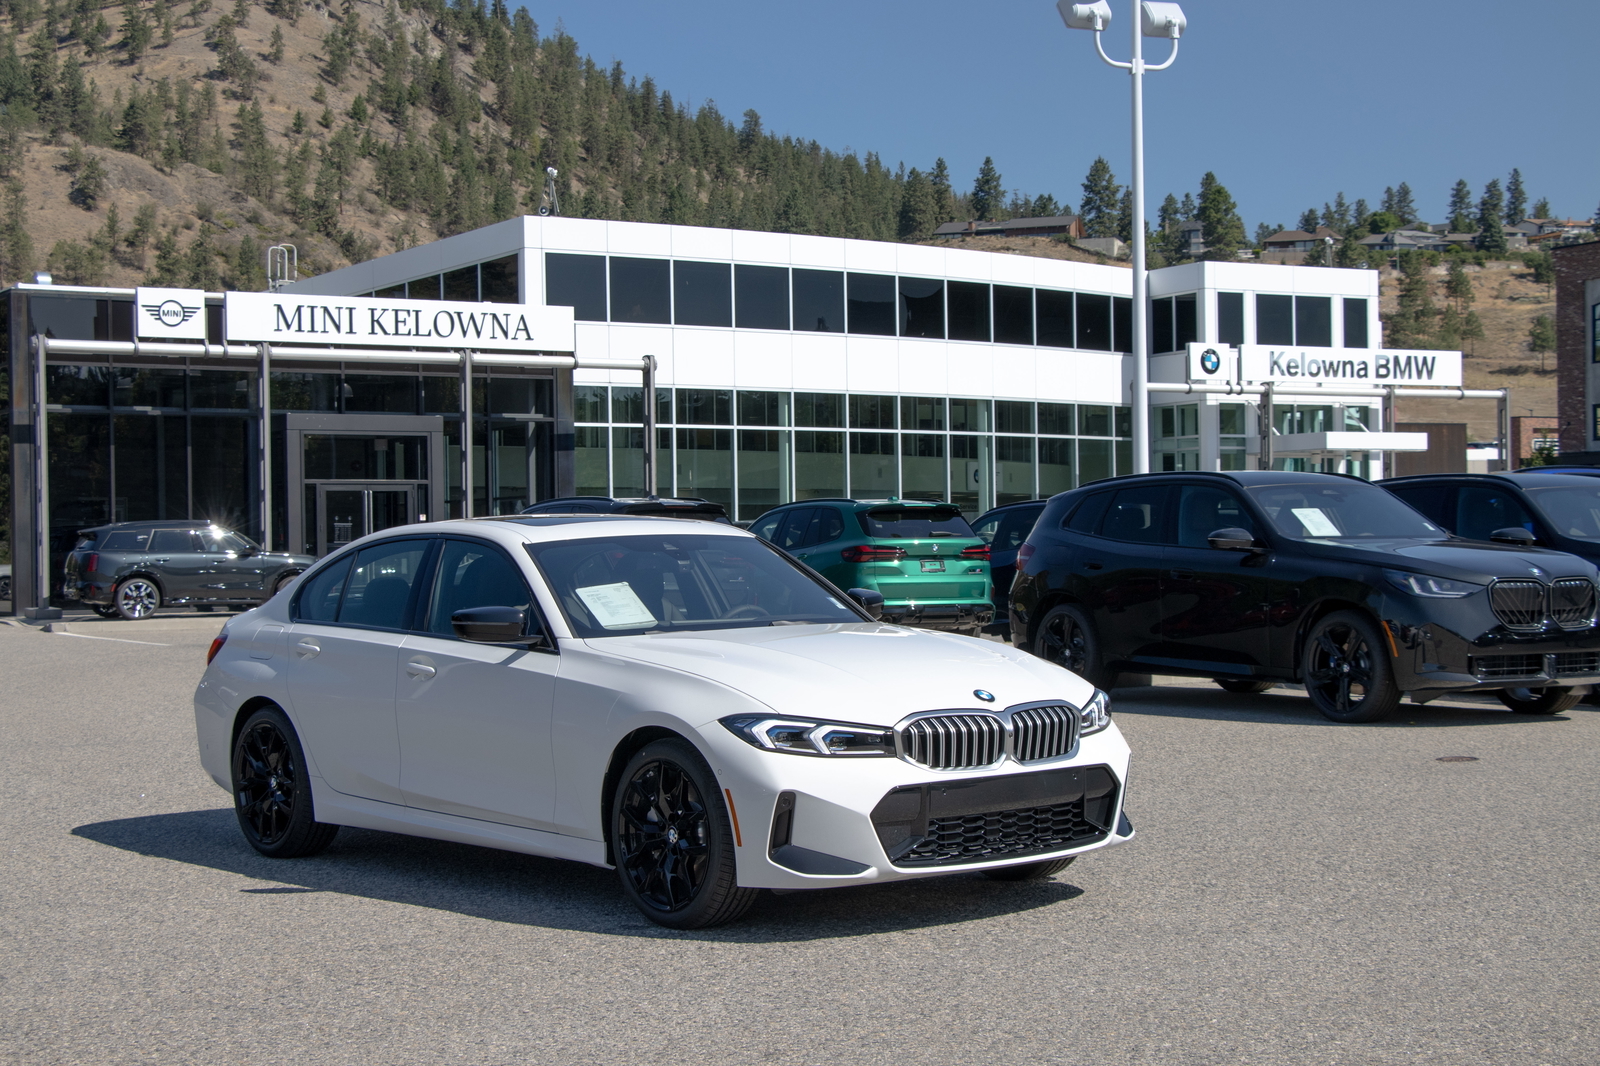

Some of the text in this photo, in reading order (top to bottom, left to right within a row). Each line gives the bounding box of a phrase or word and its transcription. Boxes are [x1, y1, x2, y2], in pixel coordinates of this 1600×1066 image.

[162, 309, 182, 318] MINI
[273, 303, 534, 341] MINI KELOWNA
[1269, 351, 1436, 380] Kelowna BMW
